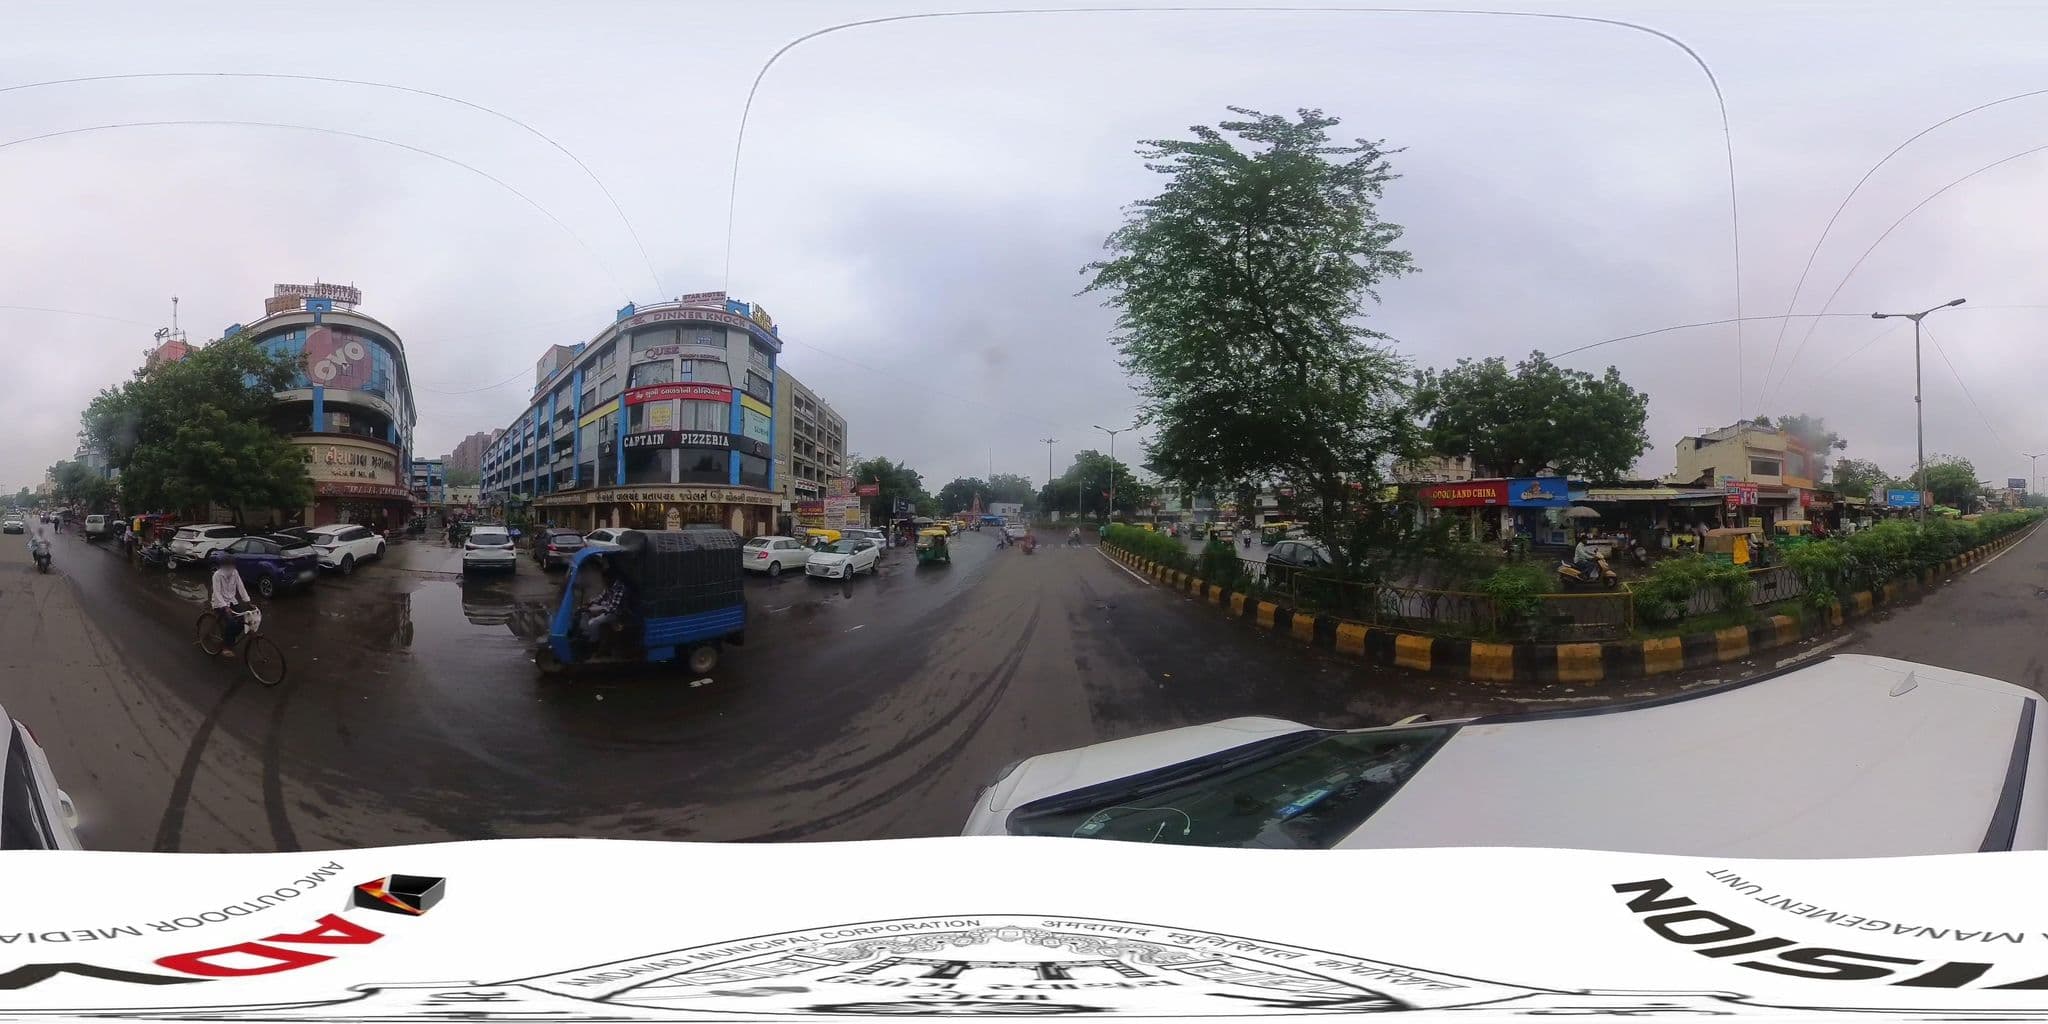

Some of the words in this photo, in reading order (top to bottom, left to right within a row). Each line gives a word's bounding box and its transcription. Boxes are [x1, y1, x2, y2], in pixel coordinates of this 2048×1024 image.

[280, 284, 308, 293] TAPAN
[315, 284, 358, 299] HOSPITAL
[702, 291, 726, 299] HOTEL
[653, 311, 703, 321] DINNER
[706, 312, 746, 328] KNOCK
[314, 341, 365, 381] OYO
[624, 434, 665, 447] CAPTAIN
[681, 433, 730, 447] PIZZERIA
[1453, 489, 1472, 500] LAND
[1473, 488, 1496, 498] CHINA
